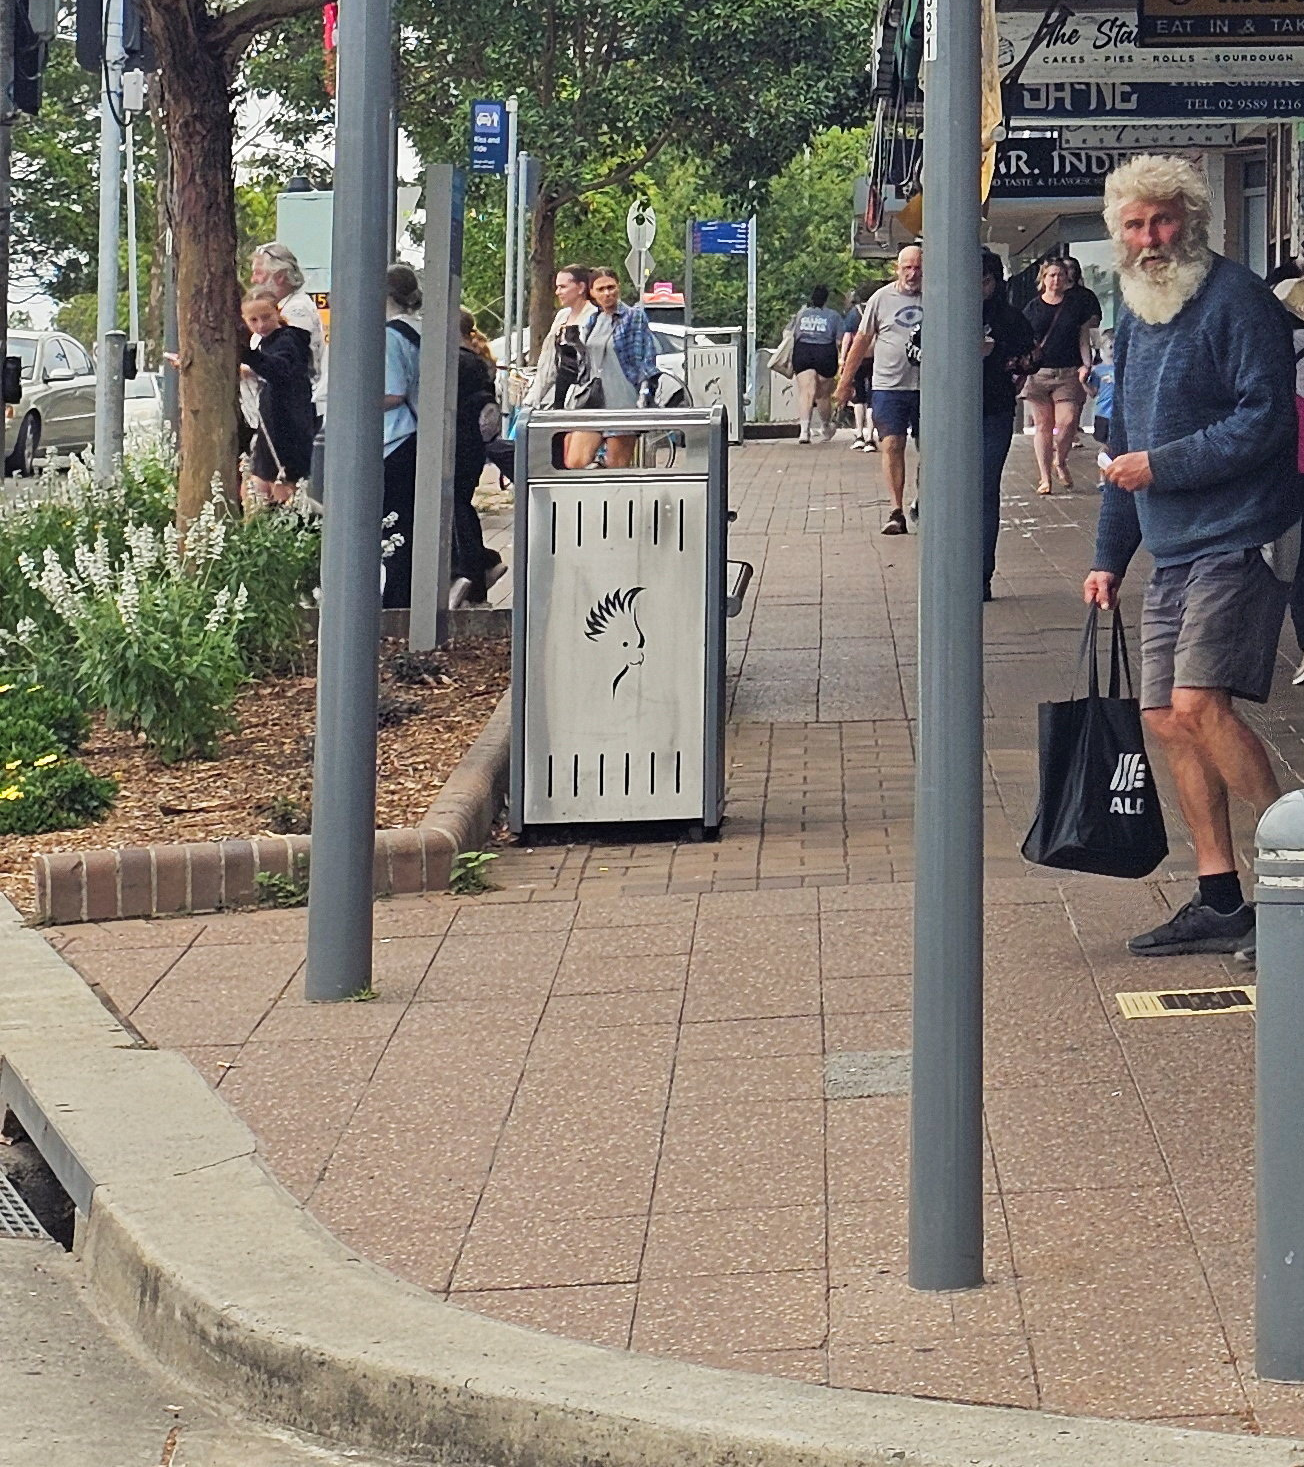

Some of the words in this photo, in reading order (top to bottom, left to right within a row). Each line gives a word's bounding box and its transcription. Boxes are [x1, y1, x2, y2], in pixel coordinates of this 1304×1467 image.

[1092, 16, 1138, 49] Sta
[1156, 18, 1196, 33] EAT
[1209, 18, 1229, 33] IN
[1242, 18, 1256, 32] &
[1042, 54, 1086, 64] CAKES
[1104, 54, 1134, 63] PIES
[1152, 54, 1195, 63] ROLLS
[1214, 53, 1294, 63] SOURDOUGH
[1184, 98, 1215, 110] TEL.
[1218, 98, 1234, 110] 02
[1237, 98, 1268, 110] 9589
[1272, 98, 1302, 110] 1216
[1109, 796, 1145, 815] ALD
